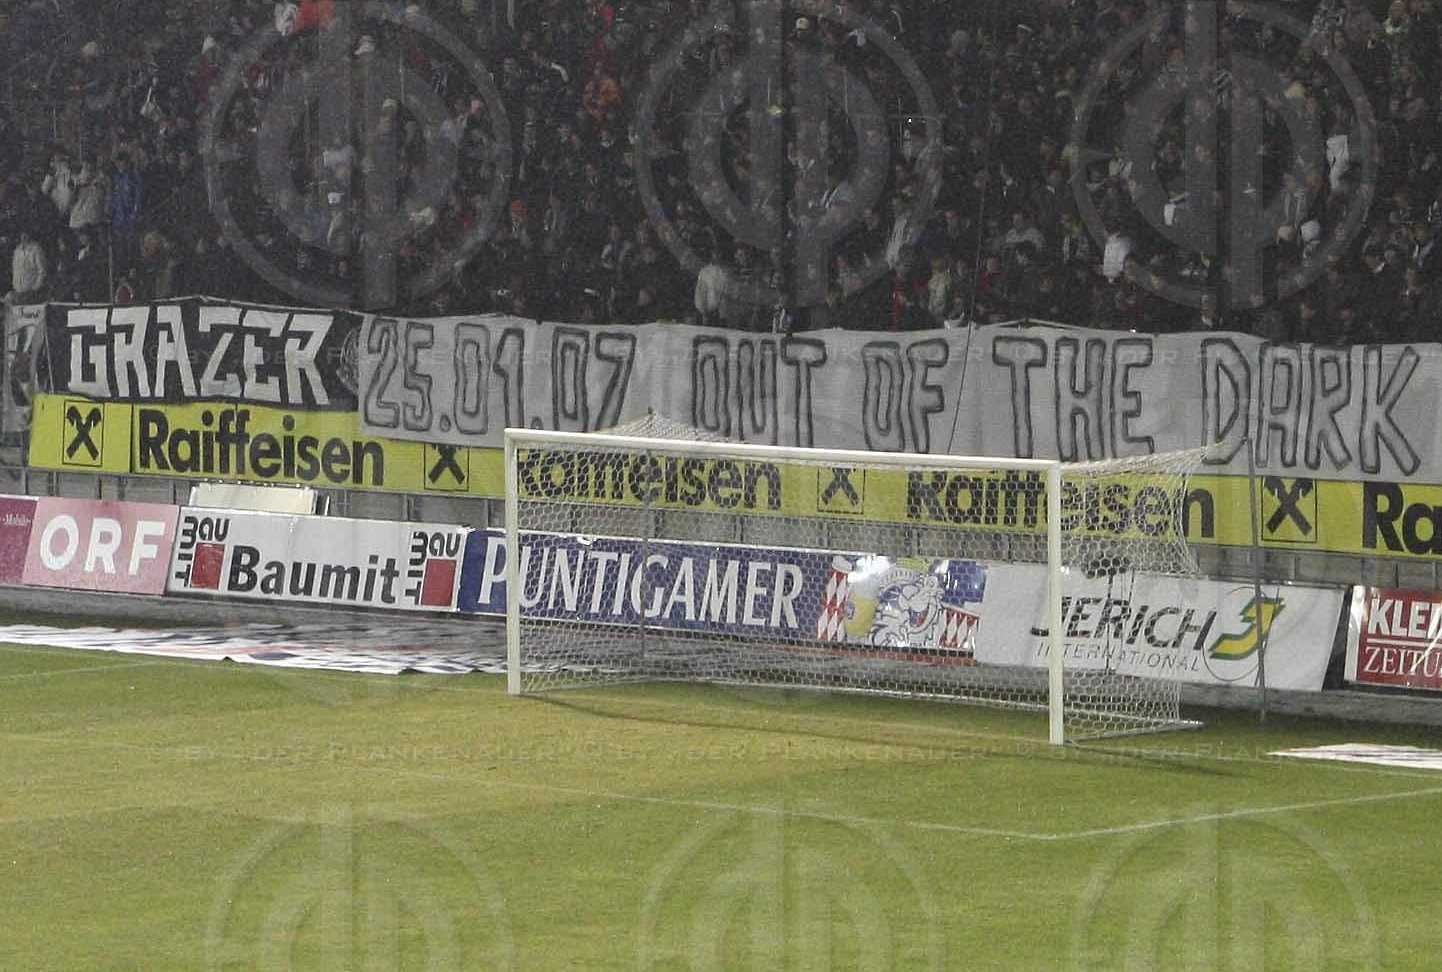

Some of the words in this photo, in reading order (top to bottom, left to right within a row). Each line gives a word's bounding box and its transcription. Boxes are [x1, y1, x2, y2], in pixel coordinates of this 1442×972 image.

[67, 306, 334, 405] GRAZER
[364, 317, 636, 434] 25.01.07
[692, 334, 827, 447] OUT
[862, 337, 951, 454] OF
[992, 335, 1155, 462] THE
[1201, 337, 1421, 476] DARK
[138, 408, 385, 486] Raiffeisen
[40, 514, 166, 575] ORF
[227, 545, 399, 603] Baumit
[478, 537, 802, 628] PUNTIGAMER
